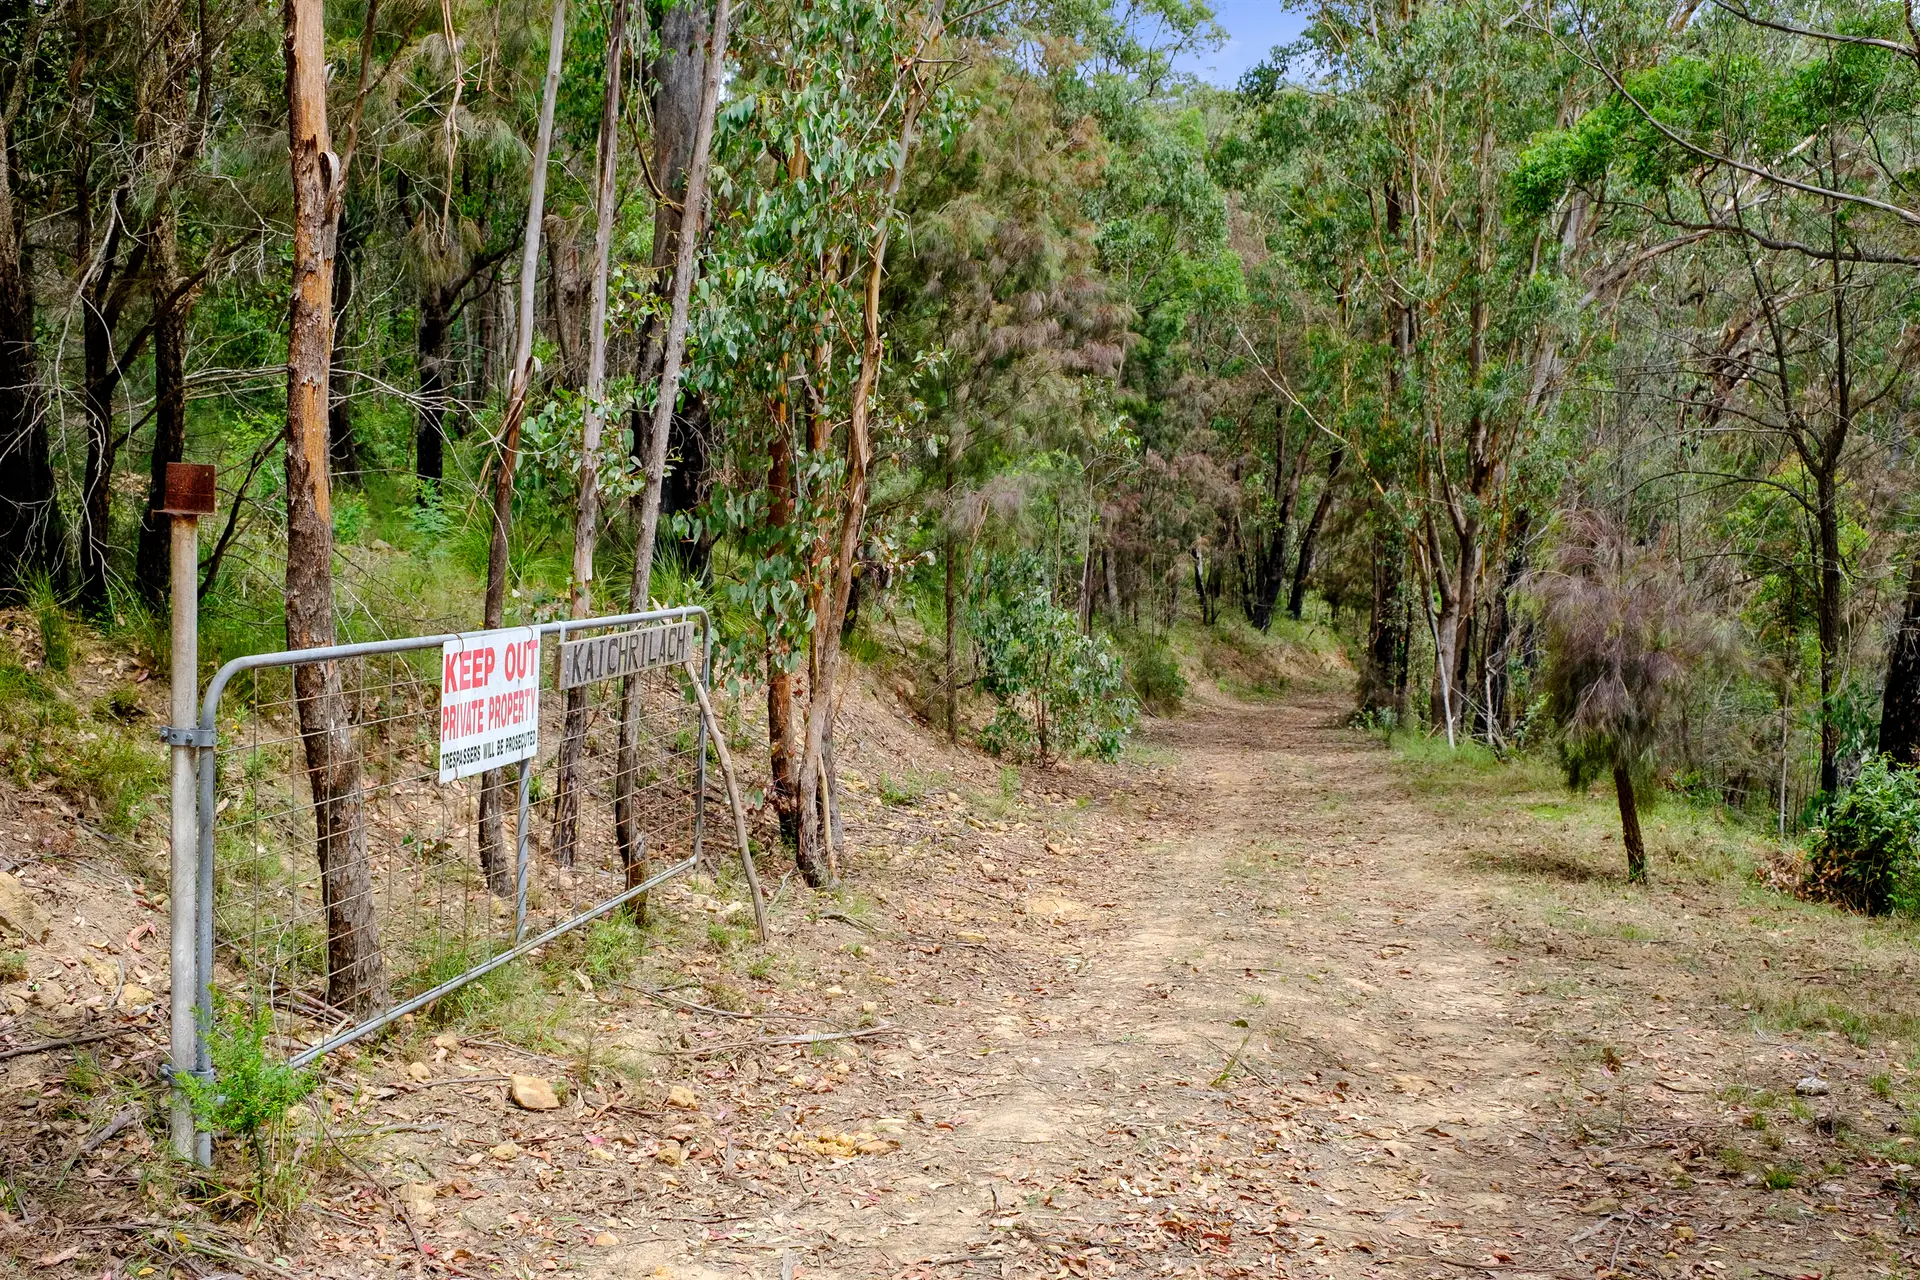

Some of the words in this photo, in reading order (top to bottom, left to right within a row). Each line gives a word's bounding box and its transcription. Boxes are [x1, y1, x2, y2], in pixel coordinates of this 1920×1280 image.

[445, 647, 495, 694] KEEP
[505, 640, 538, 682] OUT
[572, 625, 687, 683] KAICHRILACH
[442, 699, 484, 742] PRIVATE
[488, 687, 536, 731] PROPERTY
[442, 745, 481, 771] TRESPASSERS
[483, 741, 495, 760] WILL
[497, 738, 504, 756] BE
[505, 730, 536, 754] PROSECUTED
